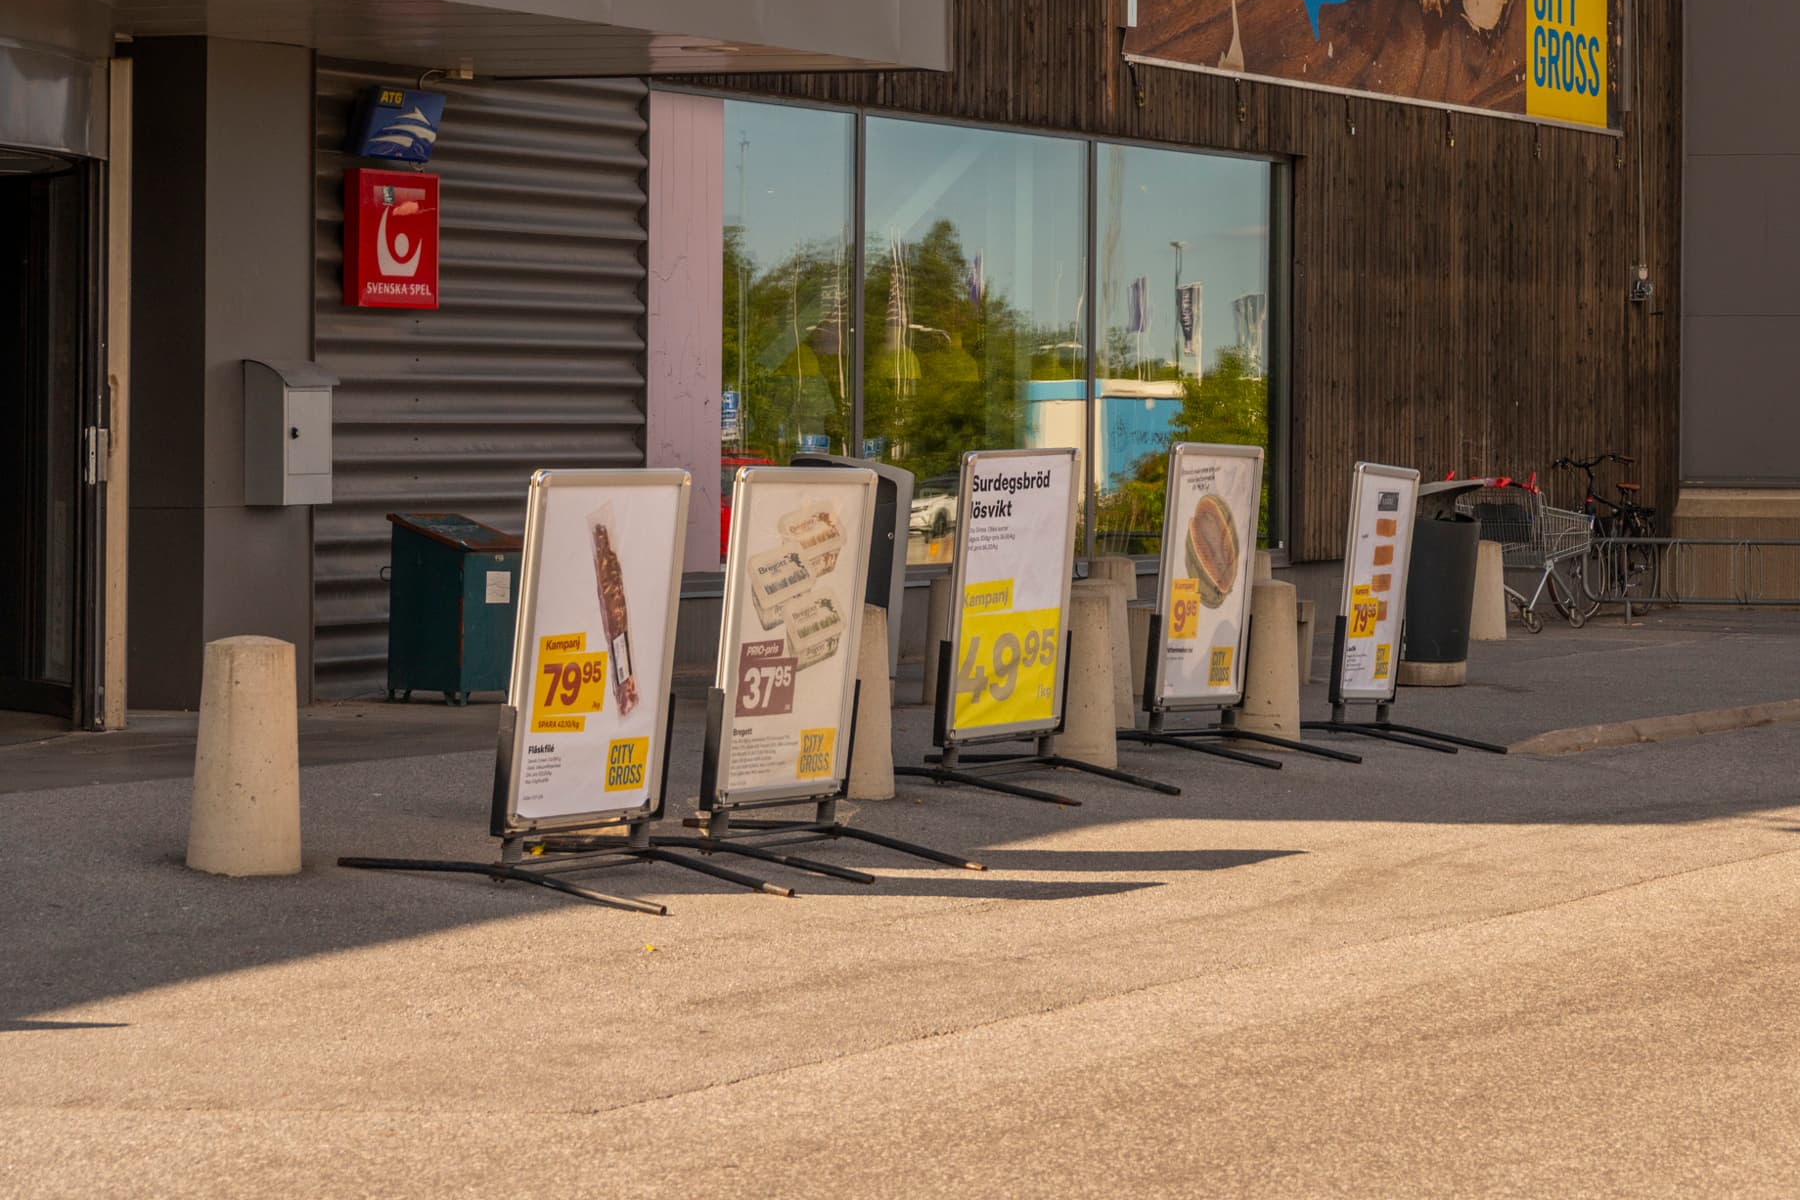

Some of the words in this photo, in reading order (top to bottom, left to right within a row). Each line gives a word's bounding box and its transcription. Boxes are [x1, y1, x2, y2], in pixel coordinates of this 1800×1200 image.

[1534, 25, 1600, 97] GROSS
[380, 90, 403, 105] ATG
[367, 282, 408, 295] SVENSKA
[409, 283, 432, 296] SPEL
[973, 470, 1050, 494] Surdegsbröd
[546, 637, 580, 650] Kampanj
[803, 734, 824, 753] CITY
[610, 744, 635, 764] CITY
[800, 753, 830, 773] GROSS
[608, 764, 643, 786] GROSS
